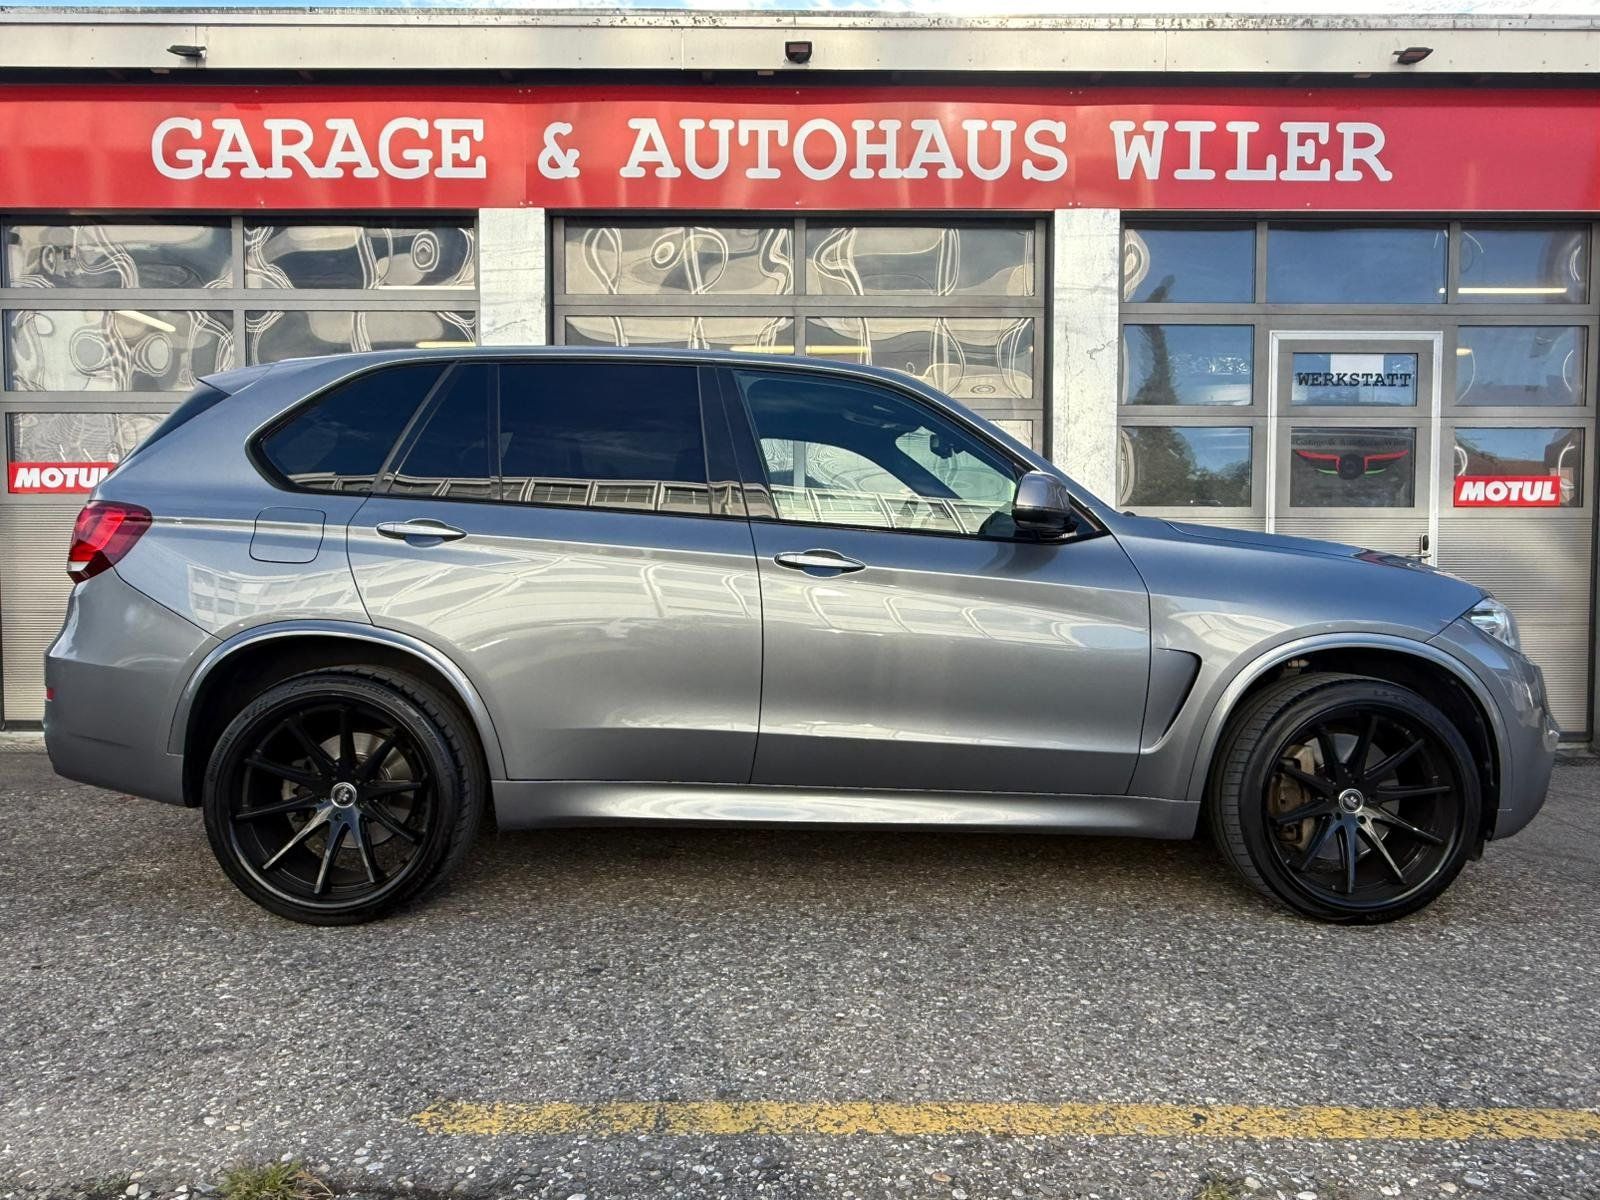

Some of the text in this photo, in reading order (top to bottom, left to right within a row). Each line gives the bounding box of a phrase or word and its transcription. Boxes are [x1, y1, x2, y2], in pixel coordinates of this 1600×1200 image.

[152, 117, 1394, 183] GARAGE & AUTOHAUS WILER
[1297, 373, 1411, 387] WERKSTATT
[1458, 480, 1556, 501] MOTUL
